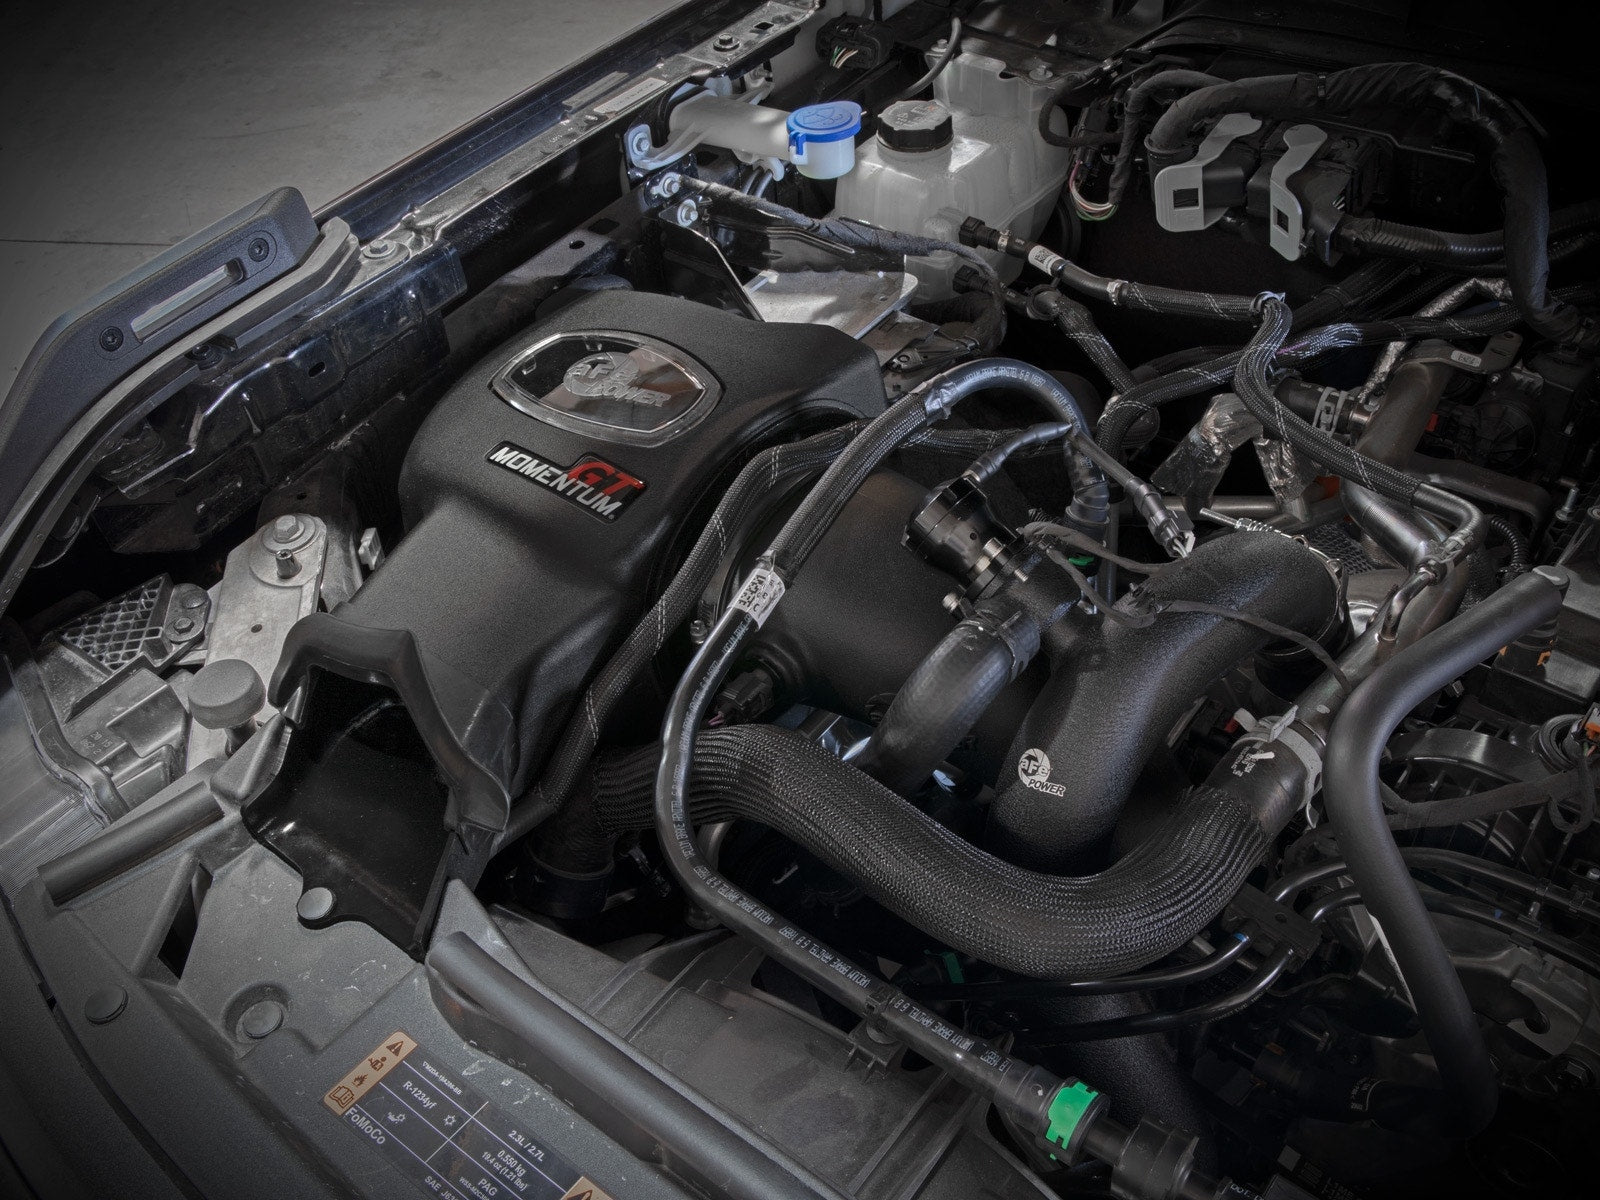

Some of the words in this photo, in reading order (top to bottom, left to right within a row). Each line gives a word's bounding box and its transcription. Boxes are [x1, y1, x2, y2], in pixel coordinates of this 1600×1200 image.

[594, 380, 672, 407] POWER
[490, 447, 622, 516] MOMENTUM
[568, 462, 644, 496] GT
[1028, 778, 1066, 797] POWER
[402, 1080, 438, 1110] R-1234yf
[345, 1107, 386, 1145] FoMoCo
[508, 1130, 527, 1148] 2.3L
[528, 1144, 545, 1162] 2.7L
[482, 1152, 496, 1164] 19.4
[493, 1161, 502, 1170] oz
[500, 1166, 516, 1181] (1.21
[514, 1176, 528, 1192] lbs)
[497, 1150, 518, 1168] 0.550
[514, 1164, 526, 1177] kg
[424, 1176, 442, 1192] SAE
[440, 1190, 459, 1200] J63
[478, 1178, 498, 1196] PAG
